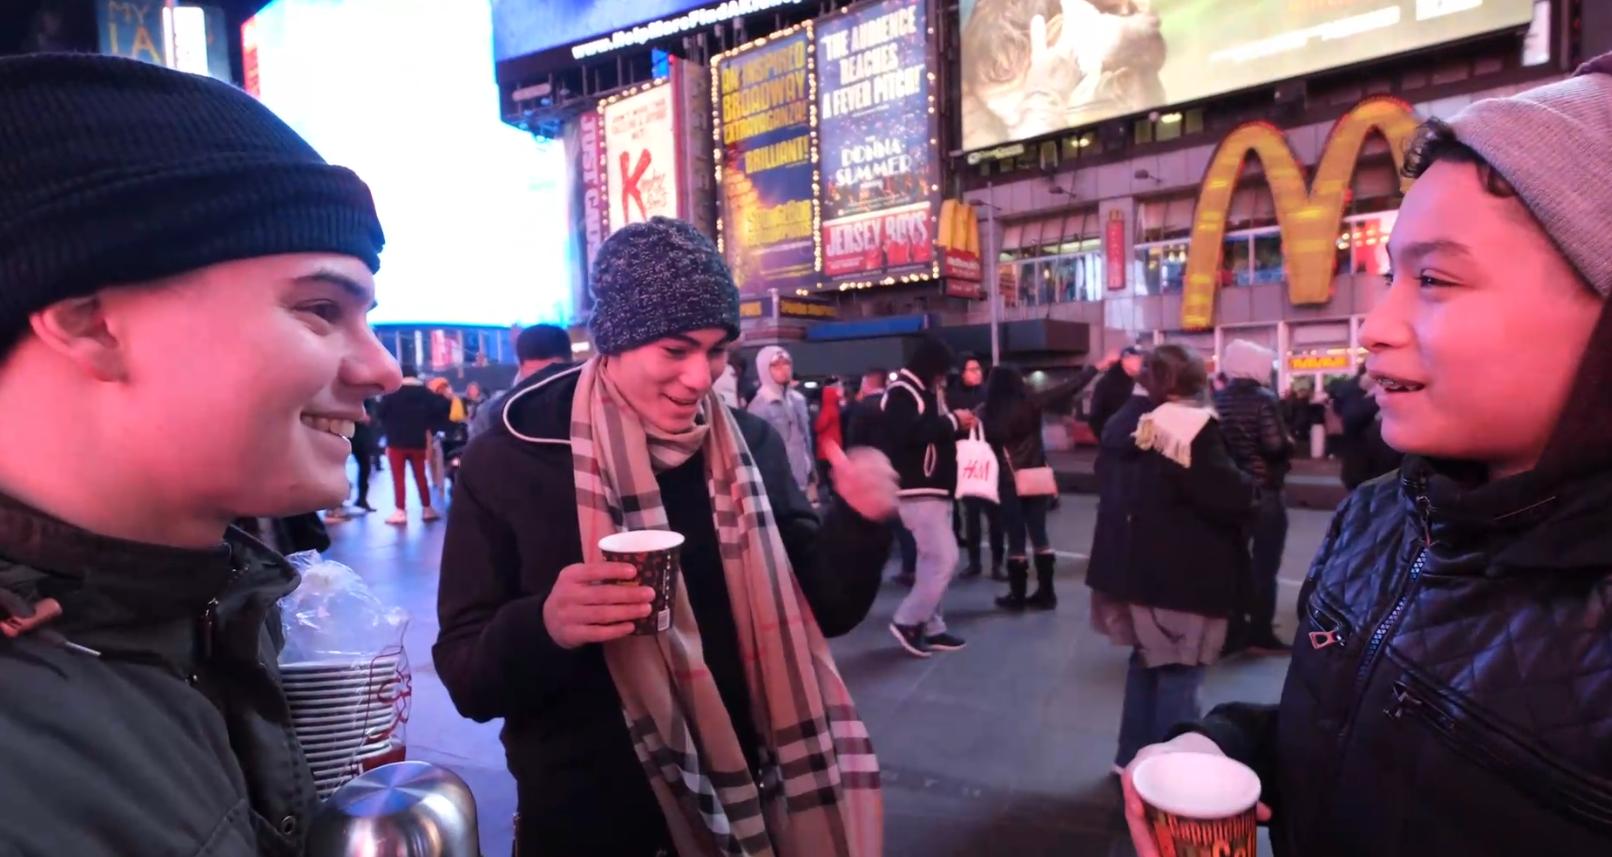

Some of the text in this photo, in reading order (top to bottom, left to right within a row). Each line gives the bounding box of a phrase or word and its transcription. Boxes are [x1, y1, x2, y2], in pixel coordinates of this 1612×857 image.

[851, 5, 917, 53] AUDIENCE
[839, 42, 898, 86] REACHES
[722, 68, 806, 123] BROADWAY
[822, 92, 833, 119] A
[833, 80, 872, 116] FEVER
[580, 113, 601, 185] JUST
[835, 154, 913, 188] SUMMER
[841, 138, 903, 168] DONNA
[826, 217, 883, 257] JERSEY
[884, 210, 929, 248] BOYS
